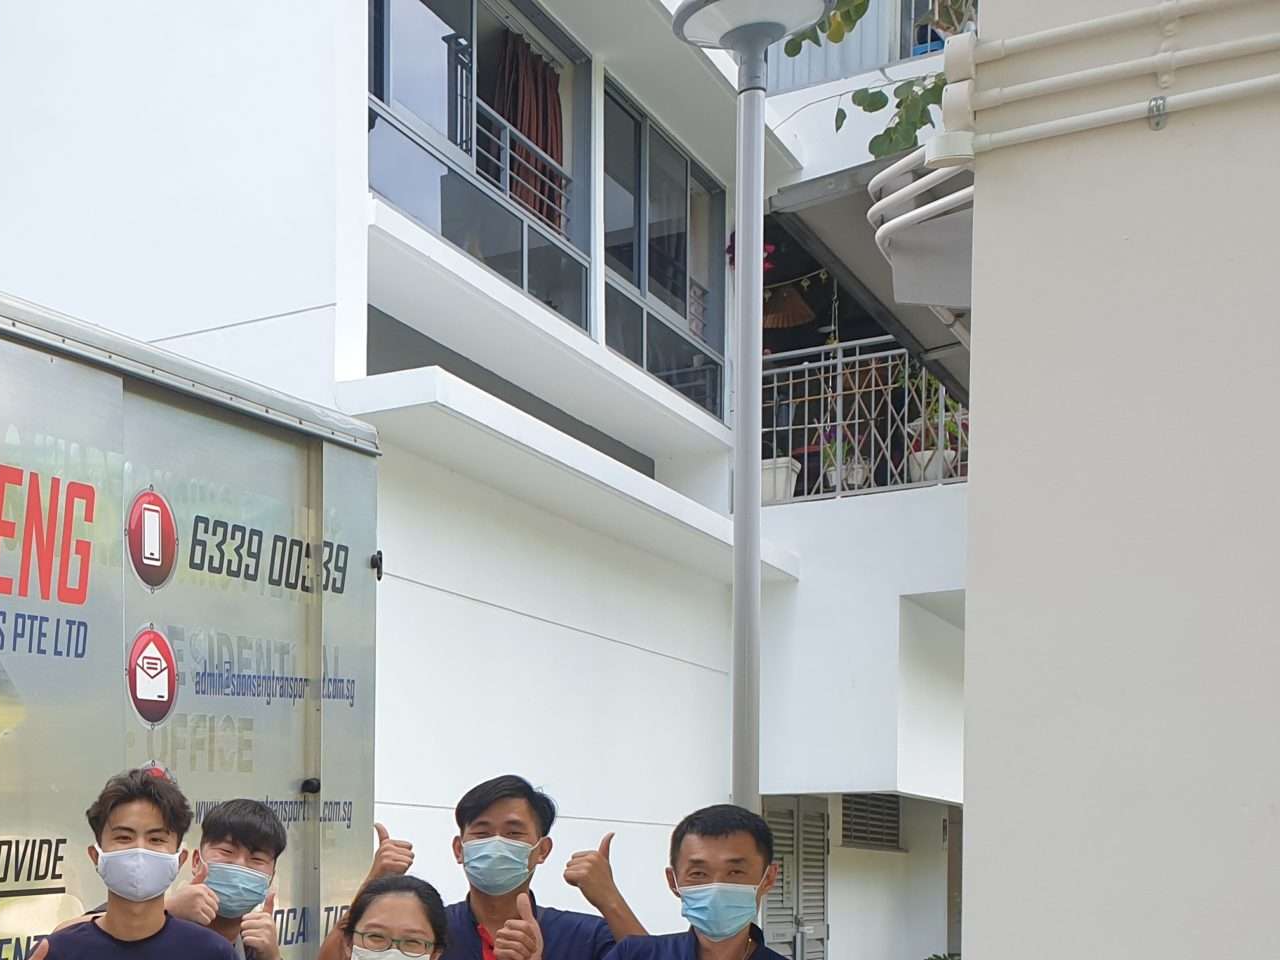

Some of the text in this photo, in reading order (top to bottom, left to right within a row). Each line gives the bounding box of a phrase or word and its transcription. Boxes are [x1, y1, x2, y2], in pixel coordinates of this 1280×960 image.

[188, 515, 264, 582] 6339
[12, 613, 50, 655] PTE
[54, 617, 89, 658] LTD
